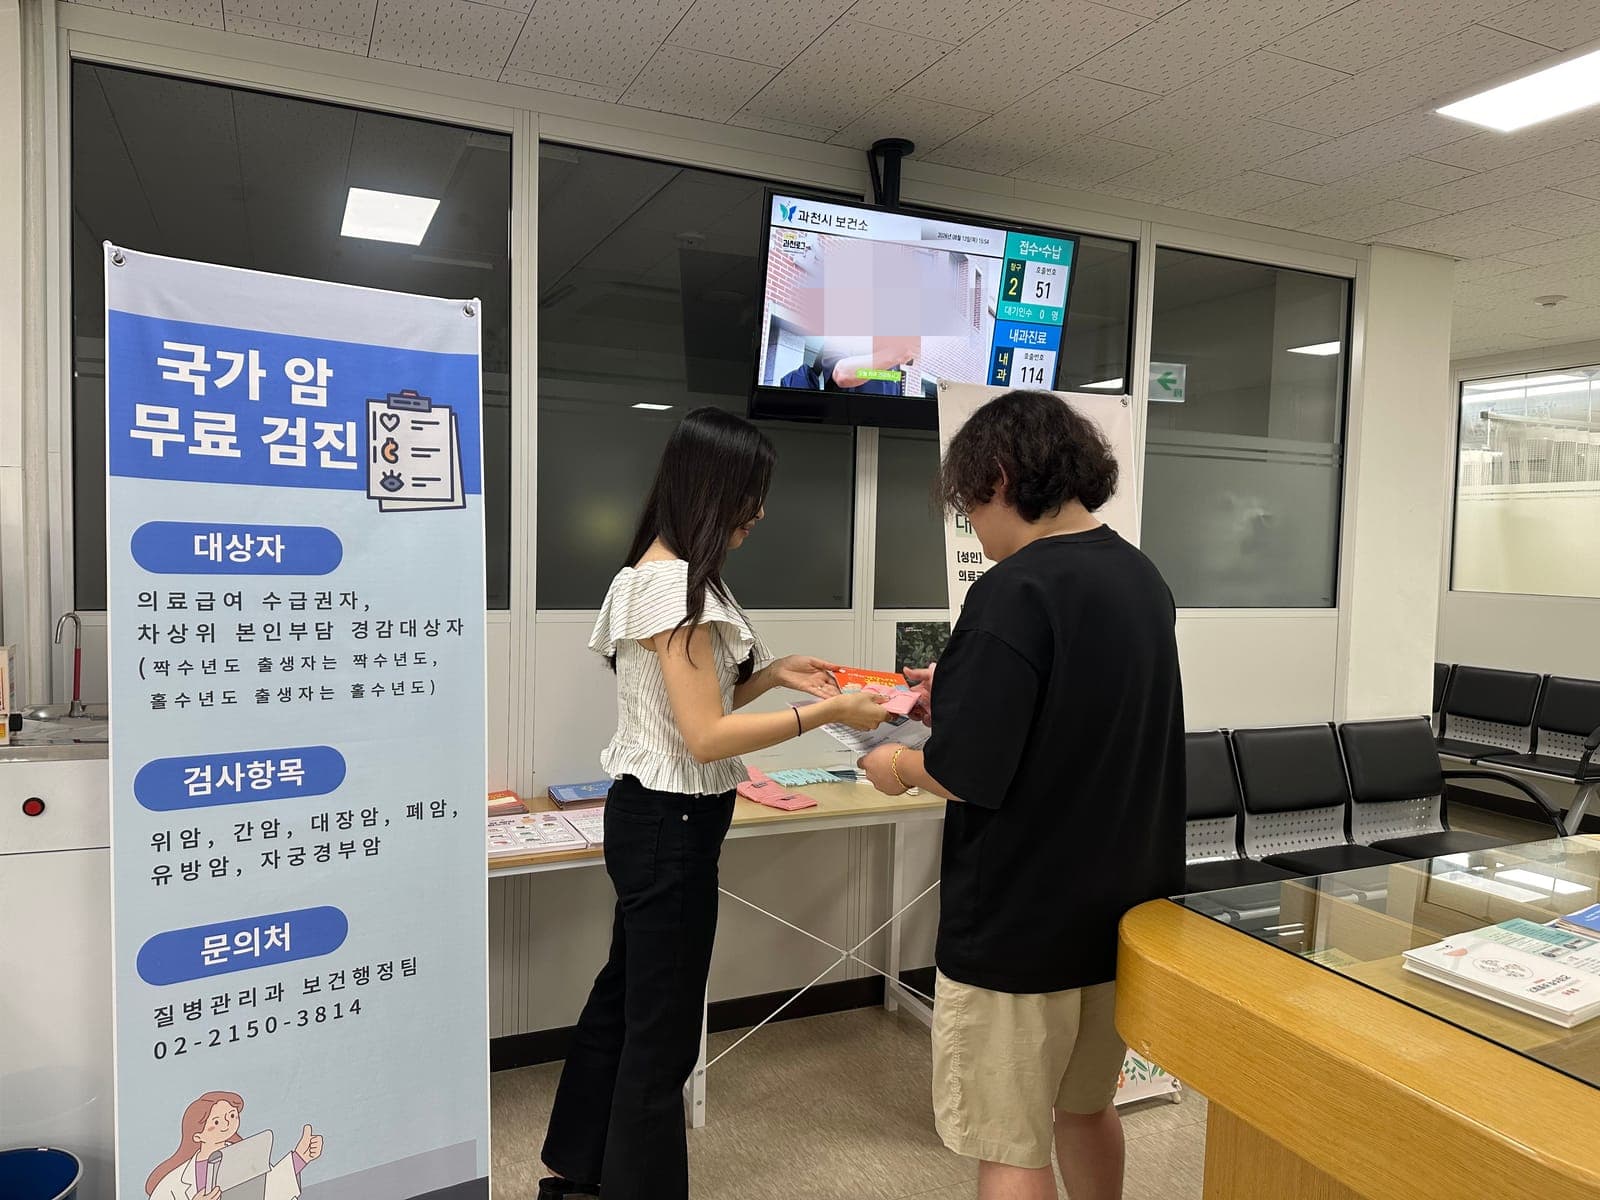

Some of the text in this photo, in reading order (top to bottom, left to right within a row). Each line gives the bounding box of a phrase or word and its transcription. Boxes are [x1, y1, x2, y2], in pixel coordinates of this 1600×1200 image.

[798, 210, 868, 232] 과천시 보건소
[1019, 240, 1062, 260] 접수·수납
[1010, 262, 1022, 272] 창구
[1036, 266, 1056, 275] 호출번호
[1008, 278, 1018, 296] 2
[1036, 281, 1050, 299] 51
[1004, 306, 1058, 321] 대기인수 0 명
[1009, 328, 1047, 344] 내과진료
[1024, 352, 1046, 361] 호출번호
[157, 340, 334, 407] 국가 암
[1021, 366, 1044, 384] 114
[130, 403, 358, 470] 무료 검진
[956, 514, 972, 534] 대
[194, 532, 285, 563] 대상자
[957, 551, 982, 564] [성인]
[137, 590, 370, 612] 의료급여 수급권자,
[137, 617, 464, 644] 차상위 본인부담 경감대상자
[138, 651, 438, 680] (짝수년도 출생자는 짝수년도,
[150, 679, 436, 710] 홀수년도 출생자는 홀수년도)
[183, 758, 305, 797] 검사항목
[150, 799, 458, 853] 위암, 간암, 대장암, 폐암,
[151, 835, 381, 886] 유방암, 자궁경부암
[201, 922, 292, 967] 문의처
[154, 957, 417, 1029] 질병관리과 보건행정팀
[154, 998, 362, 1061] 02-2150-3814
